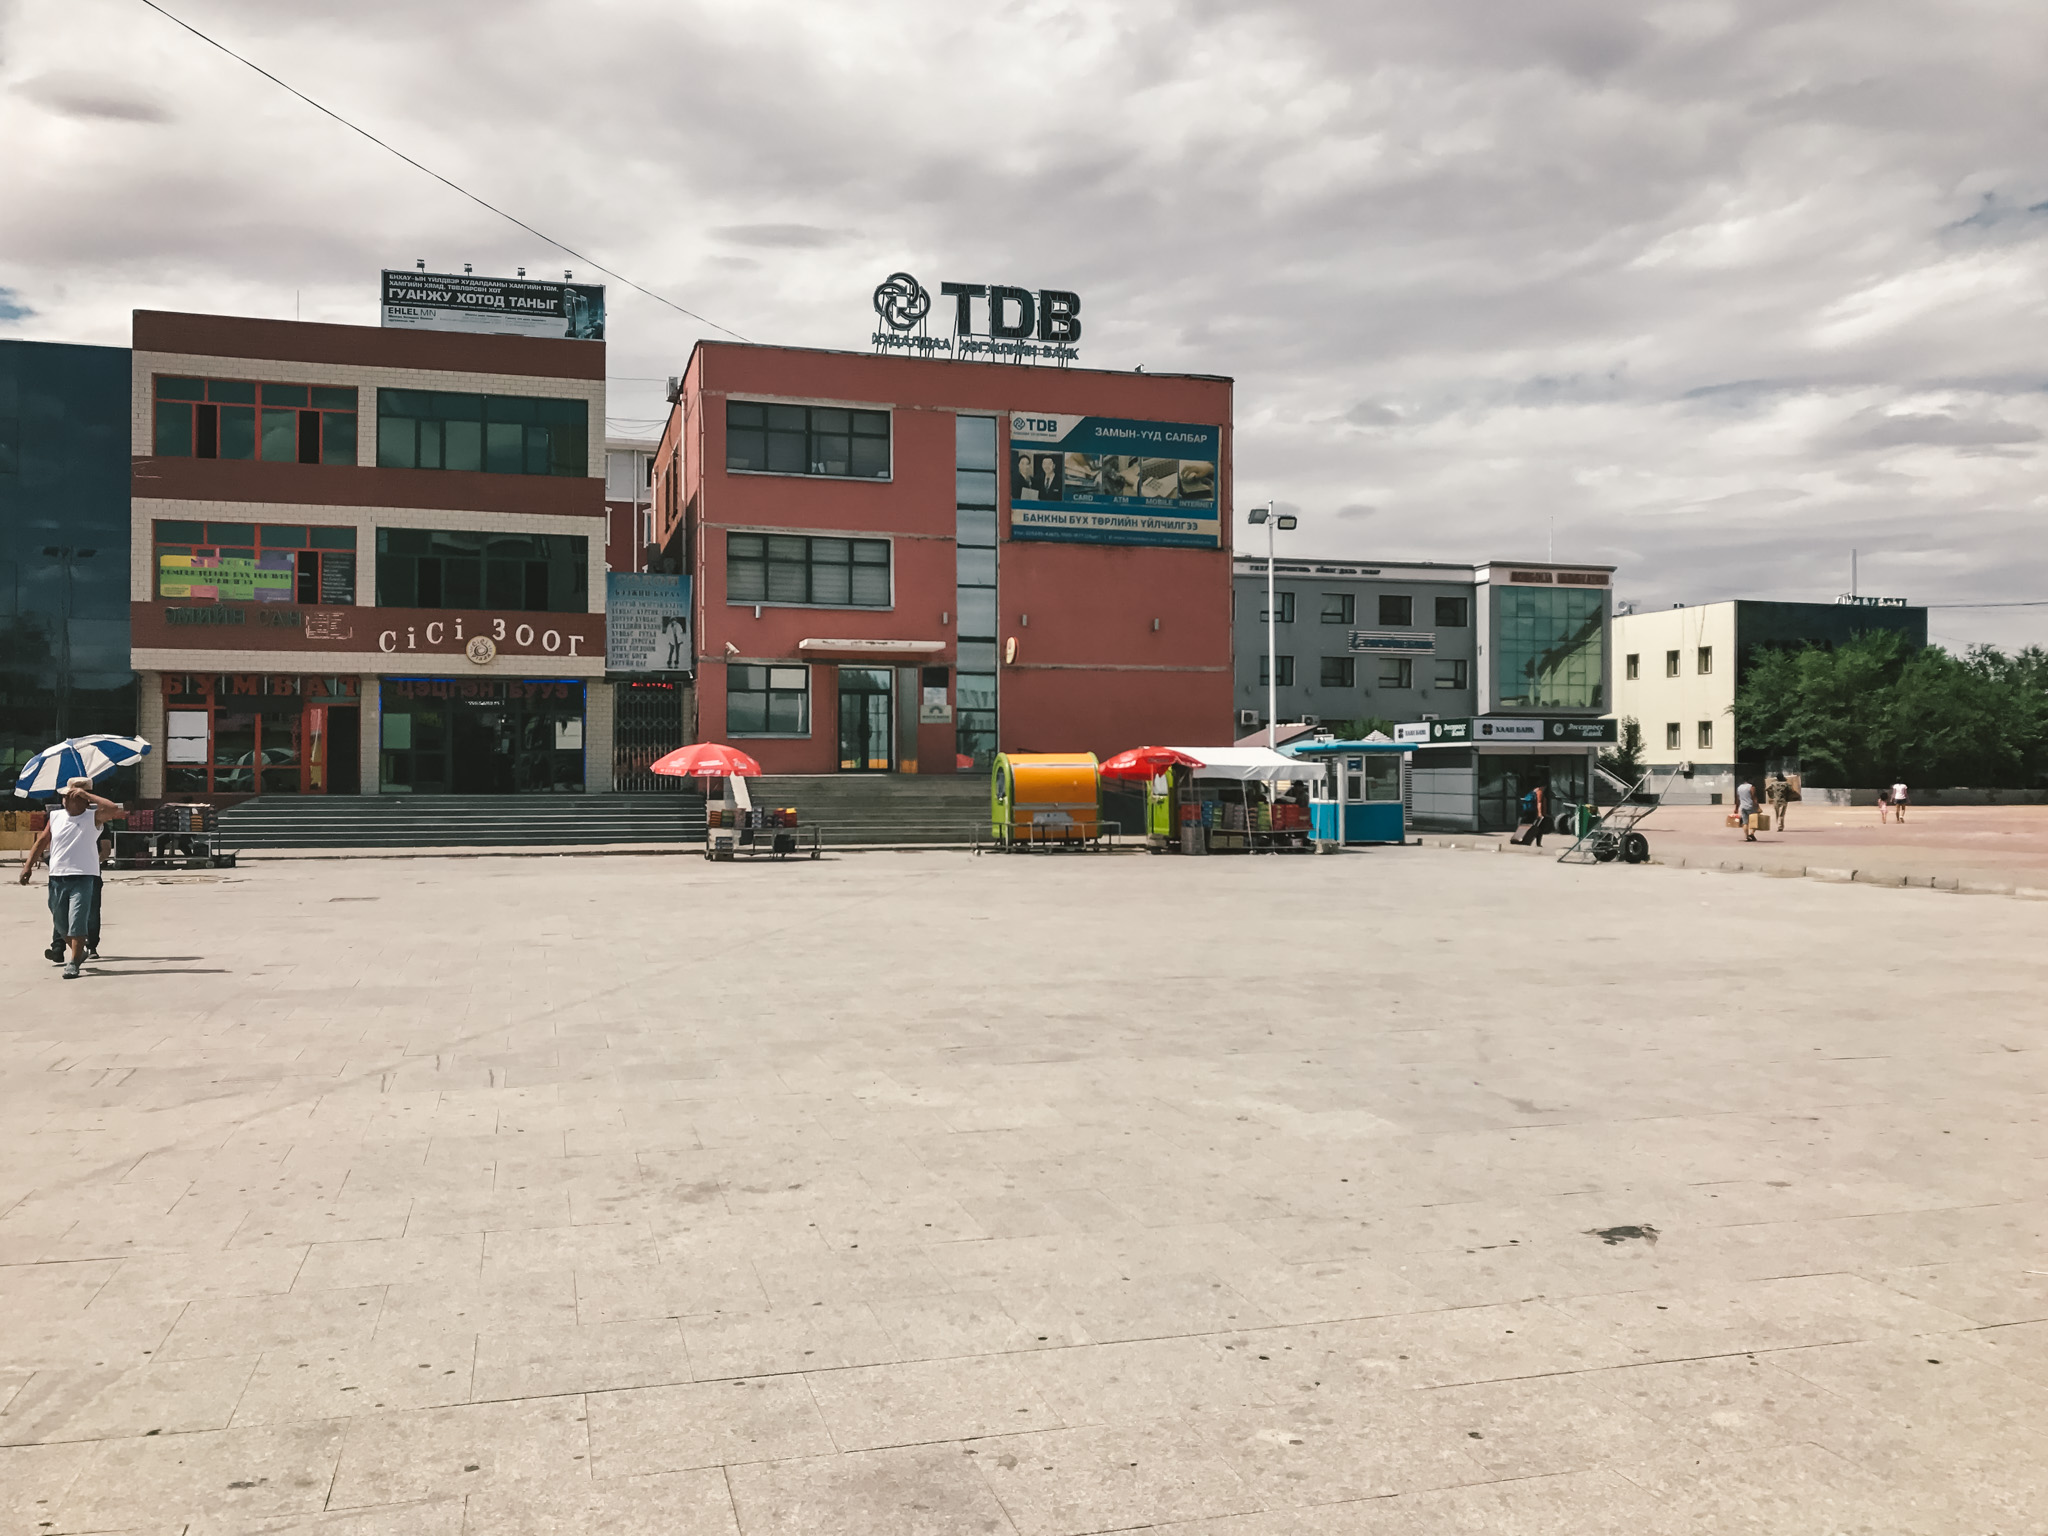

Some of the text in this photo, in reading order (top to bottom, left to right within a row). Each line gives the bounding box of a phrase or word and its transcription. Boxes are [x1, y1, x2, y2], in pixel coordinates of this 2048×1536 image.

[461, 279, 508, 288] ХУДАЛДААНЫ
[389, 288, 452, 302] ГУАНЖУ
[456, 293, 505, 308] ХОТОД
[509, 297, 558, 310] ТАНЫГ
[941, 282, 1081, 343] TDB
[872, 332, 1079, 360] ХУДАЛДАА ХӨГЖЛИЙН БАНК
[1026, 418, 1058, 433] TDB
[1095, 427, 1208, 443] ЗАМЫН-ҮҮД САЛБАР
[1073, 494, 1094, 502] CARD
[1113, 496, 1129, 504] ATM
[1145, 498, 1173, 506] MOBILE
[1179, 500, 1214, 509] INTERNET
[1023, 513, 1198, 531] БАНКНЫ БҮХ ТӨРЛИЙН ҮЙЛЧИЛГЭЭ
[165, 603, 245, 625] ЭМИЙН
[259, 609, 302, 626] САН
